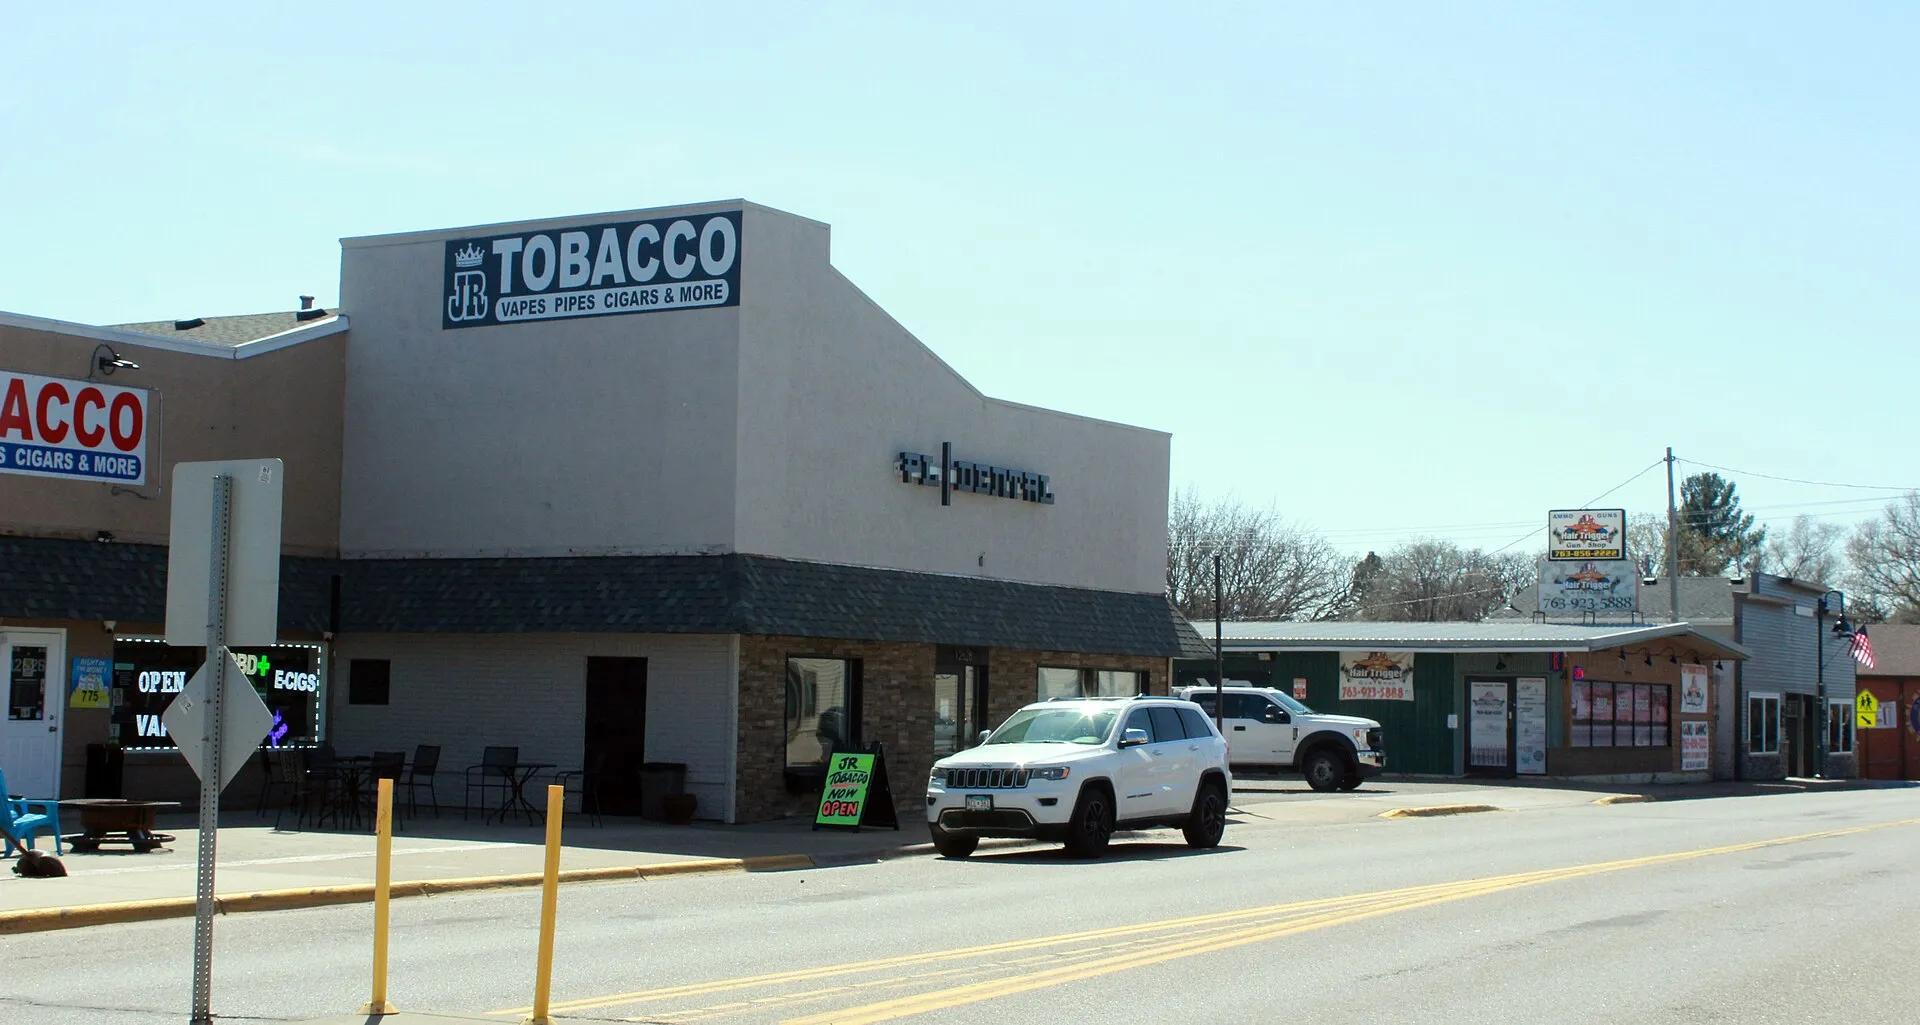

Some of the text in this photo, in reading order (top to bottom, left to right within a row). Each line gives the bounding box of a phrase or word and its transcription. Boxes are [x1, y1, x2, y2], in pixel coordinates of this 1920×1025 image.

[493, 216, 736, 294] TOBACCO
[448, 270, 488, 322] JR
[501, 284, 723, 317] VAPES PIPES CIGARS & MORE
[15, 448, 74, 470] CIGARS
[78, 454, 89, 472] &
[94, 455, 137, 476] MORE
[953, 461, 1055, 504] DENTAL
[1562, 531, 1609, 542] Hair Trigger
[1555, 549, 1617, 557] 763-856-2222
[1543, 597, 1632, 610] 763-923-5888
[274, 669, 317, 692] E-CIGS
[1349, 668, 1402, 679] Hair Trigger
[138, 671, 186, 693] OPEN
[82, 690, 99, 702] 775
[1342, 686, 1404, 698] 763-923-5888
[838, 757, 858, 770] JR
[829, 770, 869, 785] TOBACCO
[828, 789, 859, 799] NOW
[822, 800, 860, 816] OPEN
